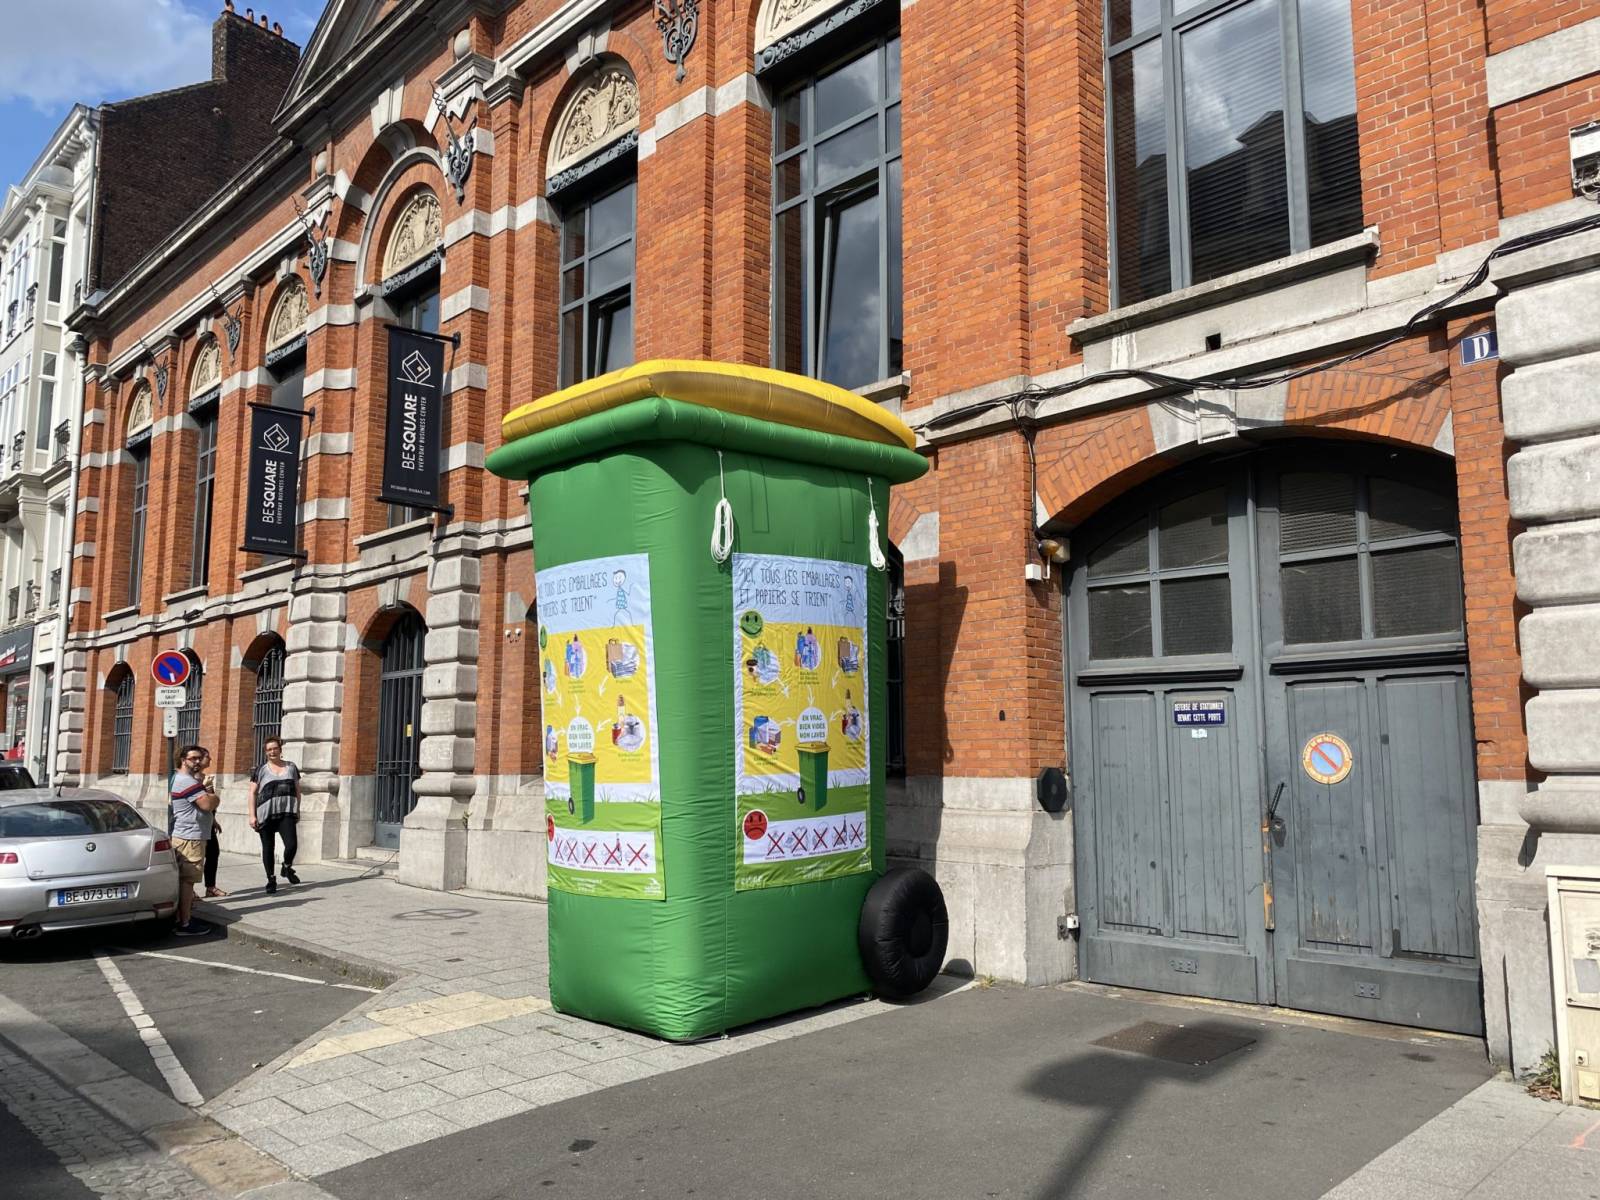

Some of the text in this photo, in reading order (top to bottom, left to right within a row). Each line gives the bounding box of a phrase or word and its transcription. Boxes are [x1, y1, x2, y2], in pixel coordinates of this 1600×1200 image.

[1472, 336, 1489, 360] D
[402, 393, 418, 470] BESQUARE
[262, 460, 277, 523] BESQUARE
[760, 568, 780, 585] TOUS
[784, 568, 798, 585] LES
[801, 570, 840, 589] EMBALLAGES
[740, 588, 750, 604] ET
[756, 588, 787, 605] PAPIERS
[791, 590, 800, 606] SE
[1193, 713, 1206, 721] CETTE
[1208, 713, 1221, 721] PORTE
